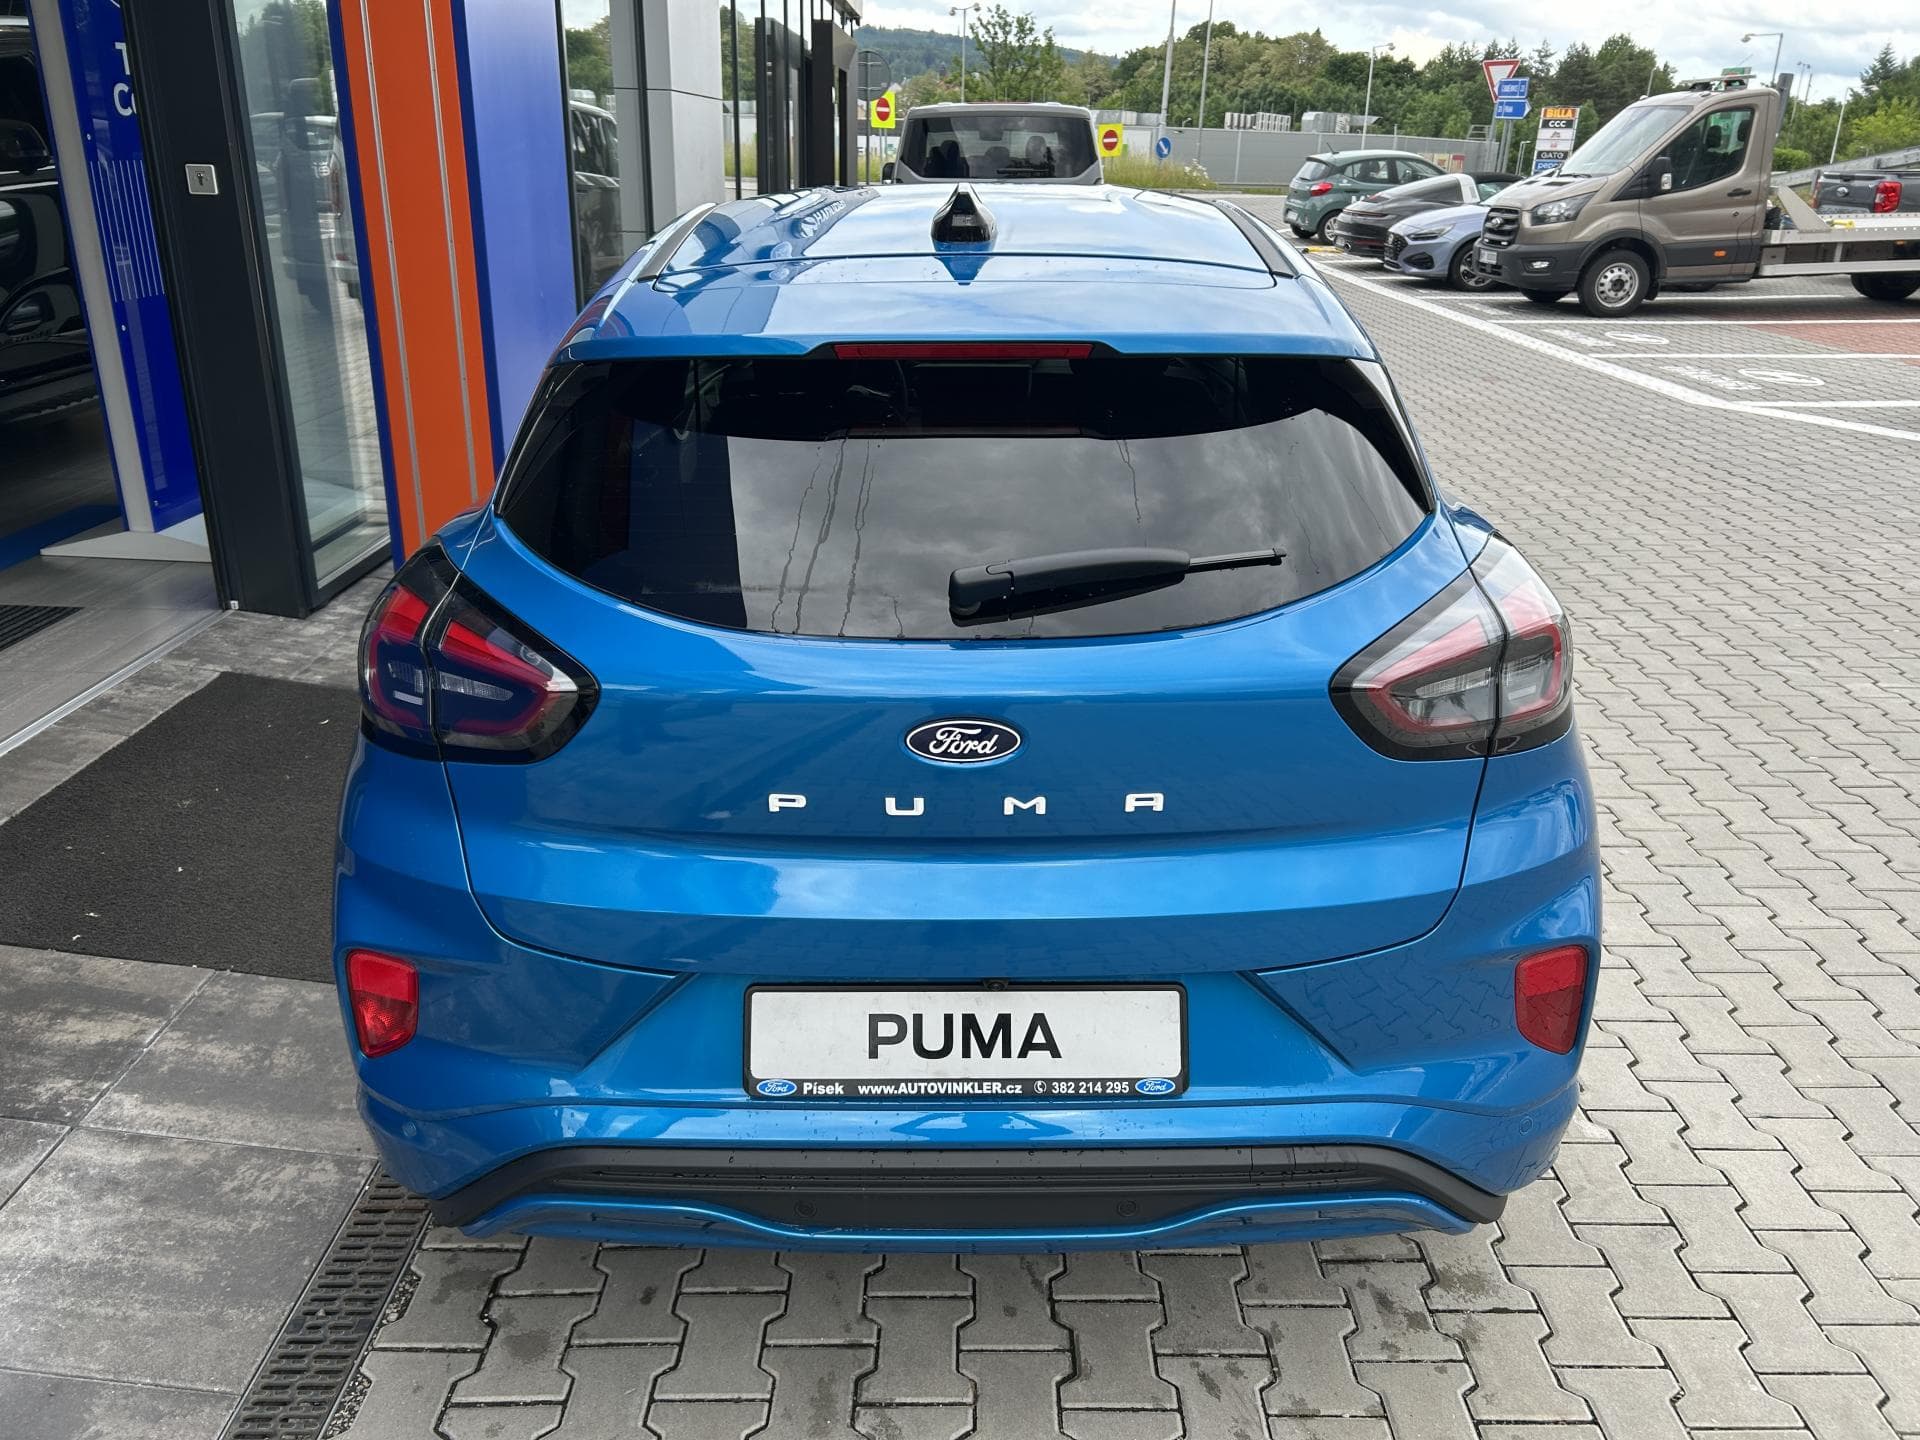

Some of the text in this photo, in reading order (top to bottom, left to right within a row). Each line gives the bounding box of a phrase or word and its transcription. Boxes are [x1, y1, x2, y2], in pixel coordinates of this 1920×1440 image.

[113, 83, 137, 116] C
[1546, 108, 1573, 118] BILLA
[929, 728, 998, 755] Ford
[768, 792, 1165, 816] PUMA
[868, 1013, 1062, 1059] PUMA
[764, 1080, 1167, 1094] Ford Písek www.AUTOVINKLER.cz 382 214 295 Ford
